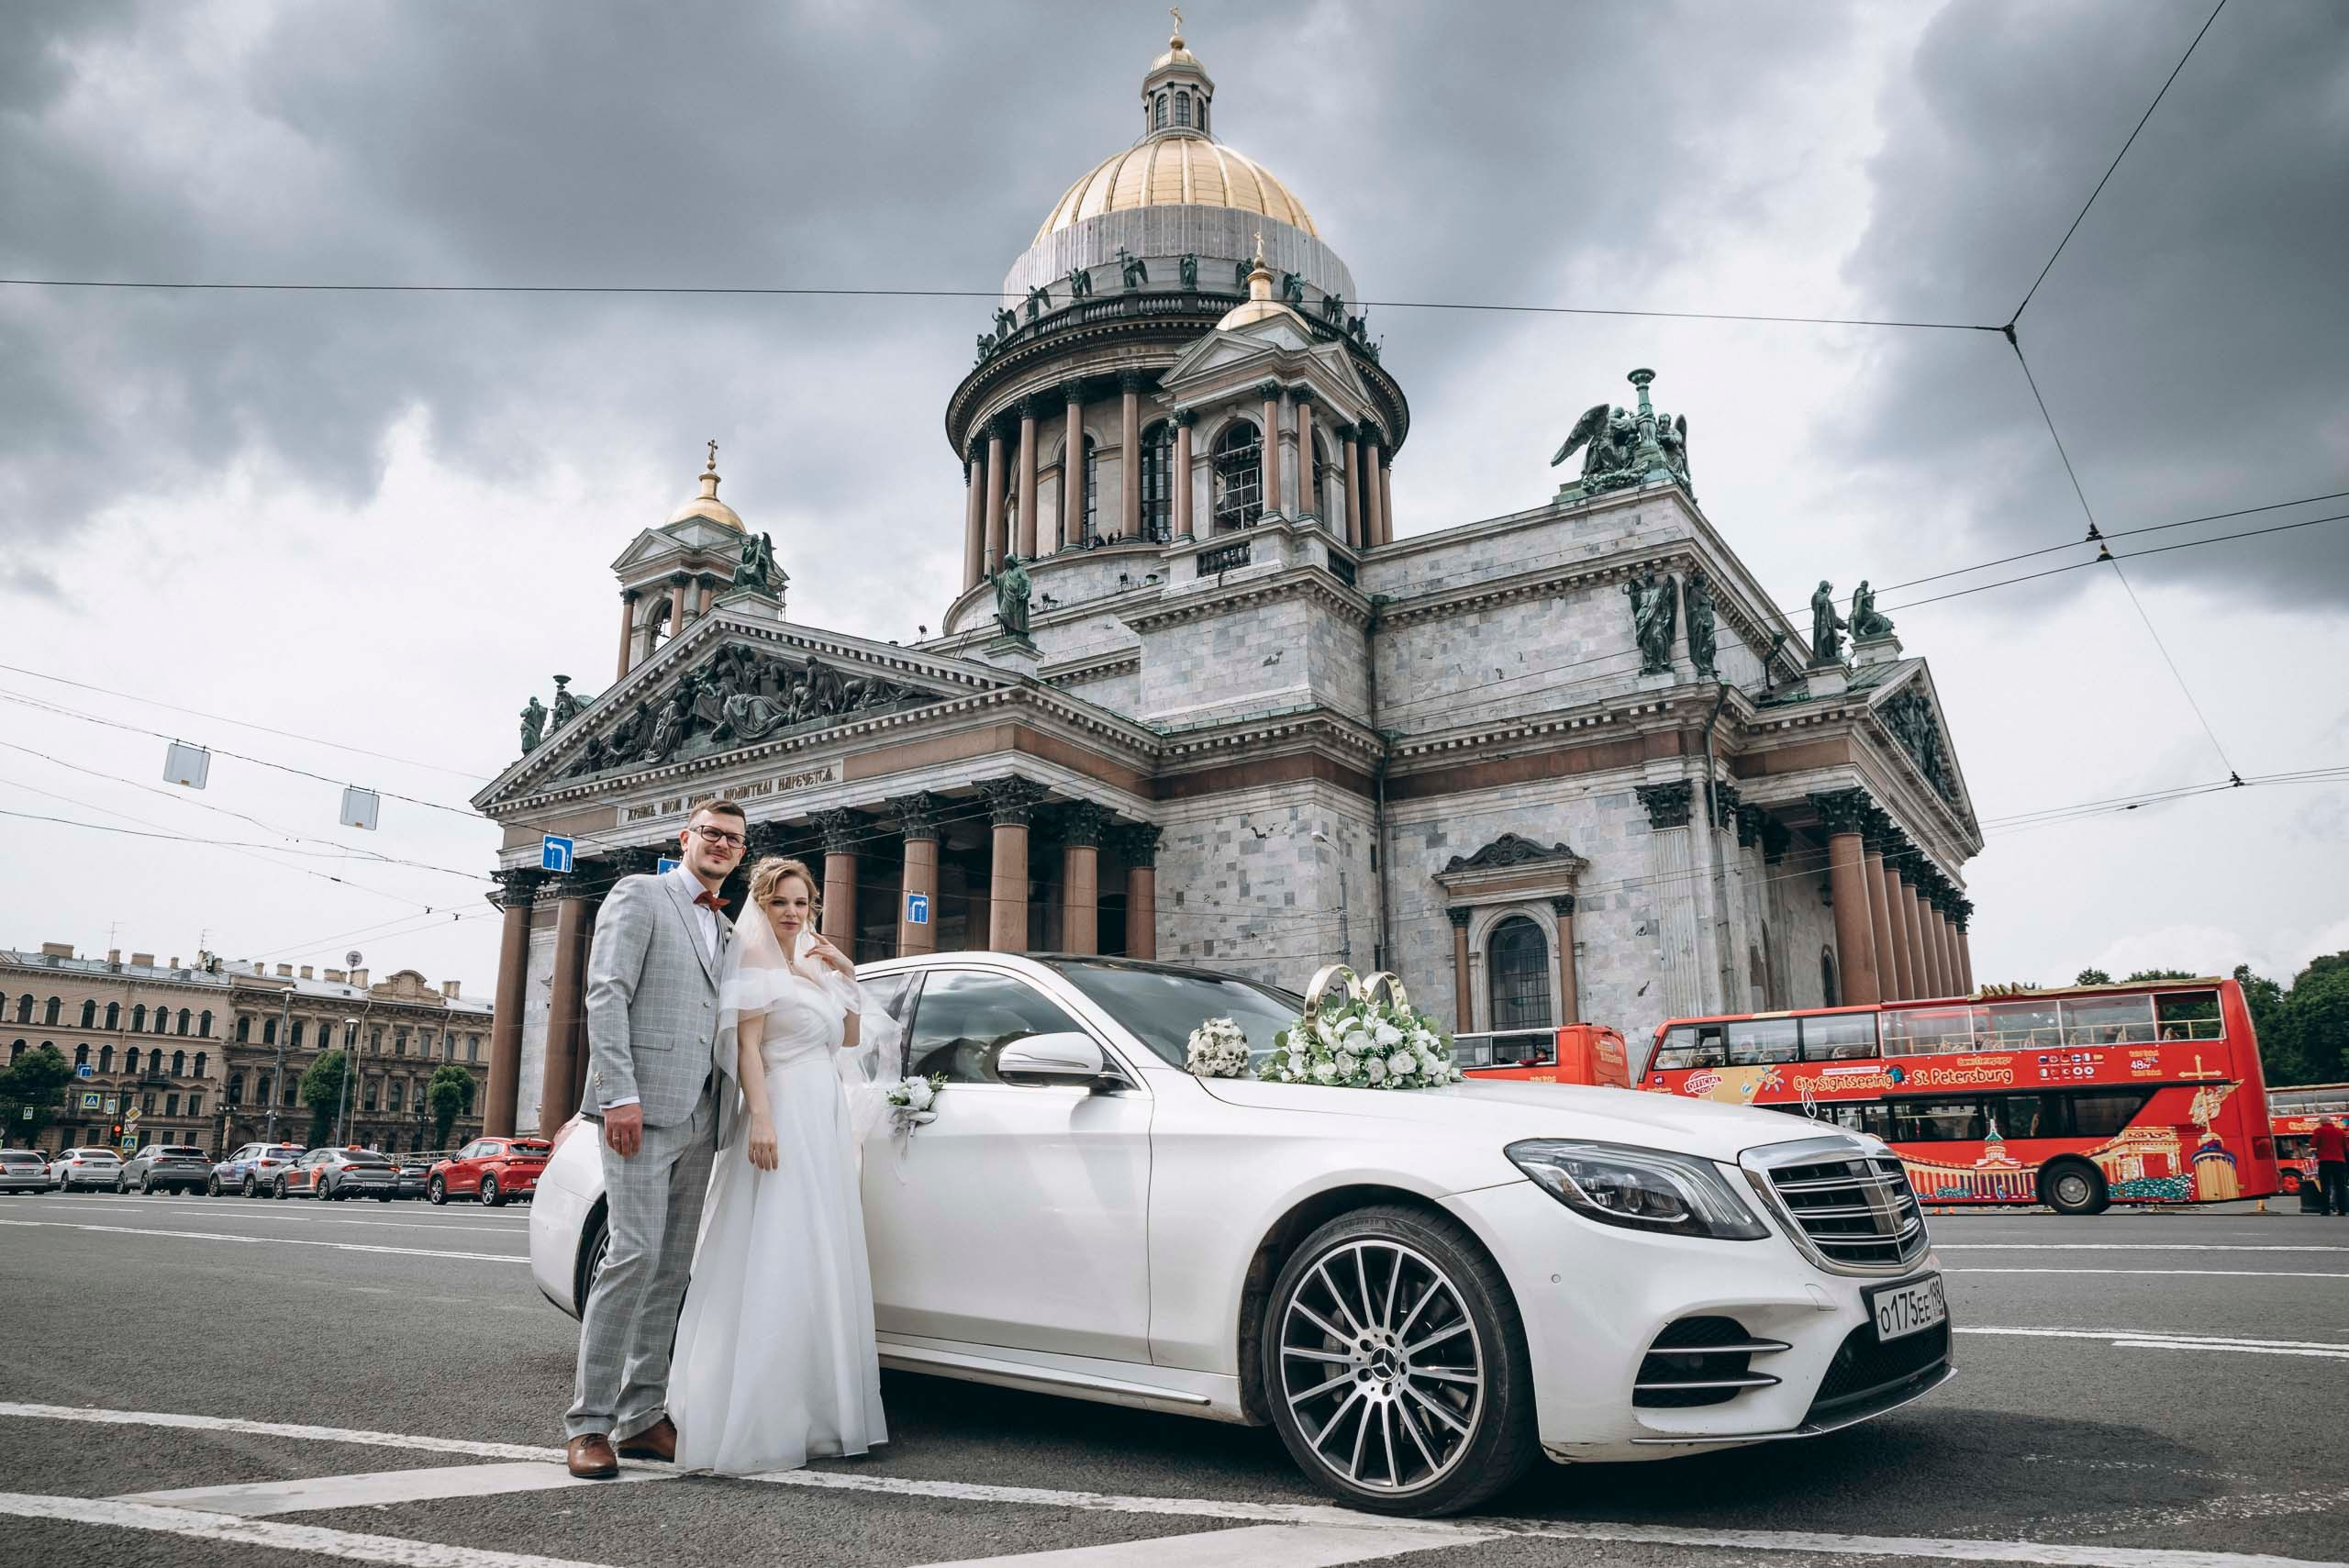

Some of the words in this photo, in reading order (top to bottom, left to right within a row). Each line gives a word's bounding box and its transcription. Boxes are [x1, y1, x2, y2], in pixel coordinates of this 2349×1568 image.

[1687, 1077, 1720, 1090] OFFICIAL
[1794, 1074, 1894, 1092] CitySightseeing
[1914, 1070, 1930, 1085] St
[1932, 1067, 2012, 1084] Petersburg
[1929, 1280, 1943, 1308] 198
